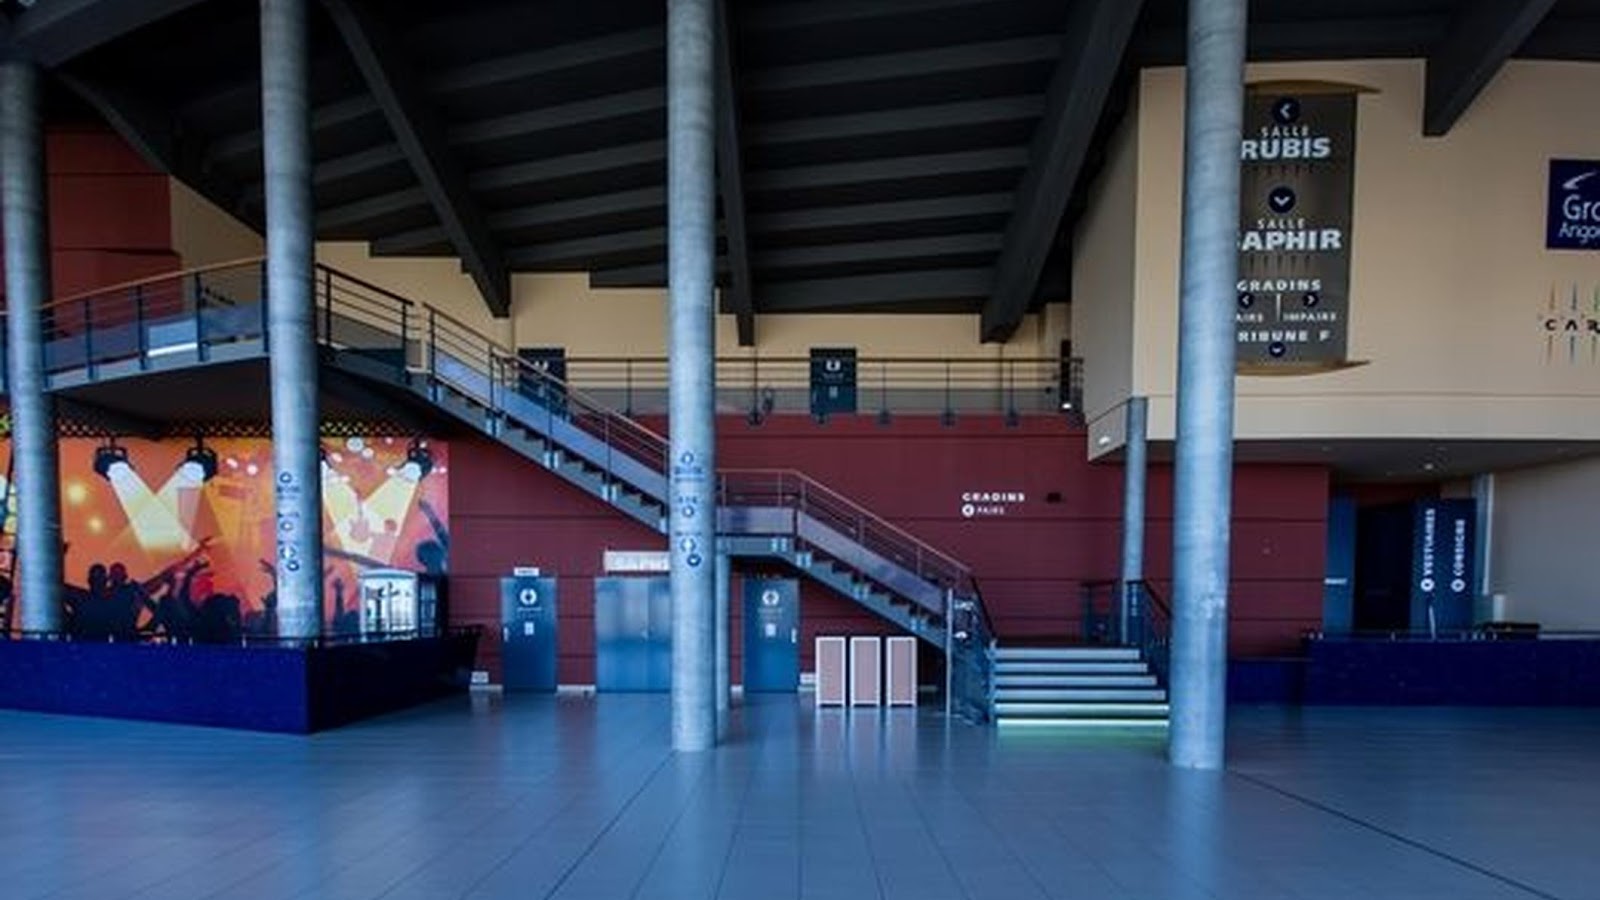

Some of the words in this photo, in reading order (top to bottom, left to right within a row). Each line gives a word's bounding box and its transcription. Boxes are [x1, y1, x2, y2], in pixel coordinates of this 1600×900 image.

[1261, 126, 1309, 137] SALLE
[1241, 137, 1331, 160] RUBIS
[1257, 218, 1305, 230] SALLE
[1238, 229, 1342, 251] APHIR
[1236, 279, 1322, 292] GRADINS
[1282, 311, 1337, 322] IMPAIRS
[1238, 329, 1308, 342] RIBUNE
[1319, 328, 1331, 342] F
[961, 491, 1025, 503] GRADINS
